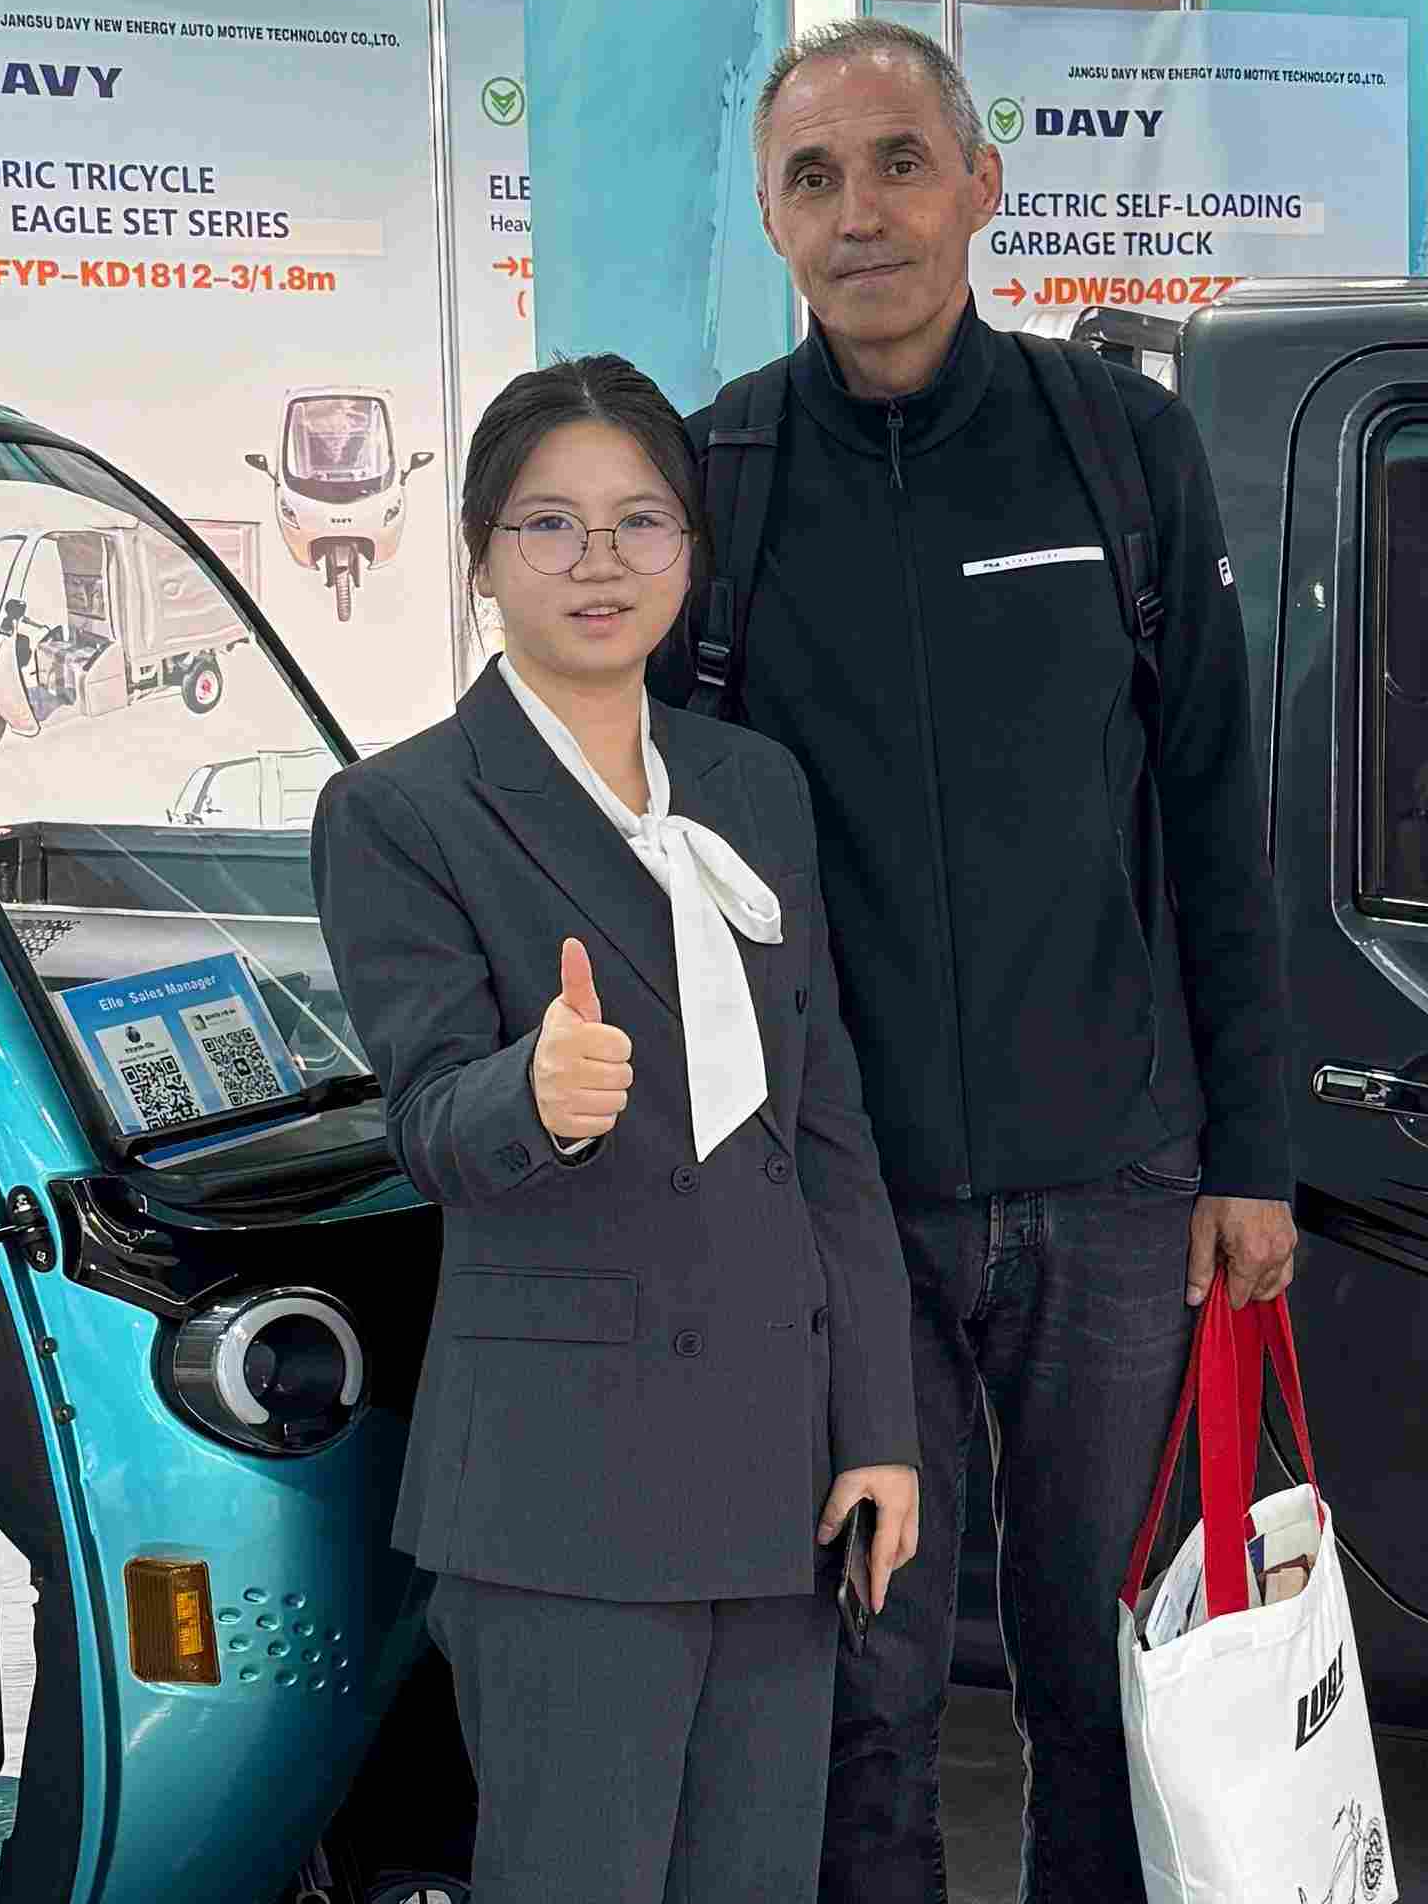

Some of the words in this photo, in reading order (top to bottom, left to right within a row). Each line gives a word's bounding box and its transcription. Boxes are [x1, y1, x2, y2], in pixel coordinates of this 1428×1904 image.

[0, 12, 53, 31] JANGSU
[56, 14, 90, 32] DAVY
[93, 17, 122, 34] NEW
[126, 18, 176, 37] ENERGY
[180, 22, 213, 38] AUTO
[217, 25, 263, 41] MOTIVE
[266, 27, 347, 45] TECHNOLOGY
[1068, 65, 1108, 80] JANGSU
[1112, 66, 1138, 81] DAVY
[1141, 66, 1165, 81] NEW
[1168, 66, 1212, 82] ENERGY
[1215, 67, 1241, 81] AUTO
[1244, 68, 1281, 82] MOTIVE
[1283, 69, 1345, 85] TECHNOLOGY
[1035, 108, 1164, 138] DAVY
[64, 160, 215, 194] TRICYCLE
[996, 192, 1107, 218] LECTRIC
[1116, 192, 1302, 218] SELF-LOADING
[11, 205, 112, 237] EAGLE
[123, 208, 177, 237] SET
[188, 210, 290, 240] SERIES
[991, 230, 1116, 257] GARBAGE
[1124, 231, 1213, 257] TRUCK
[1034, 276, 1243, 306] JDW5040ZZ
[166, 974, 217, 995] Manager
